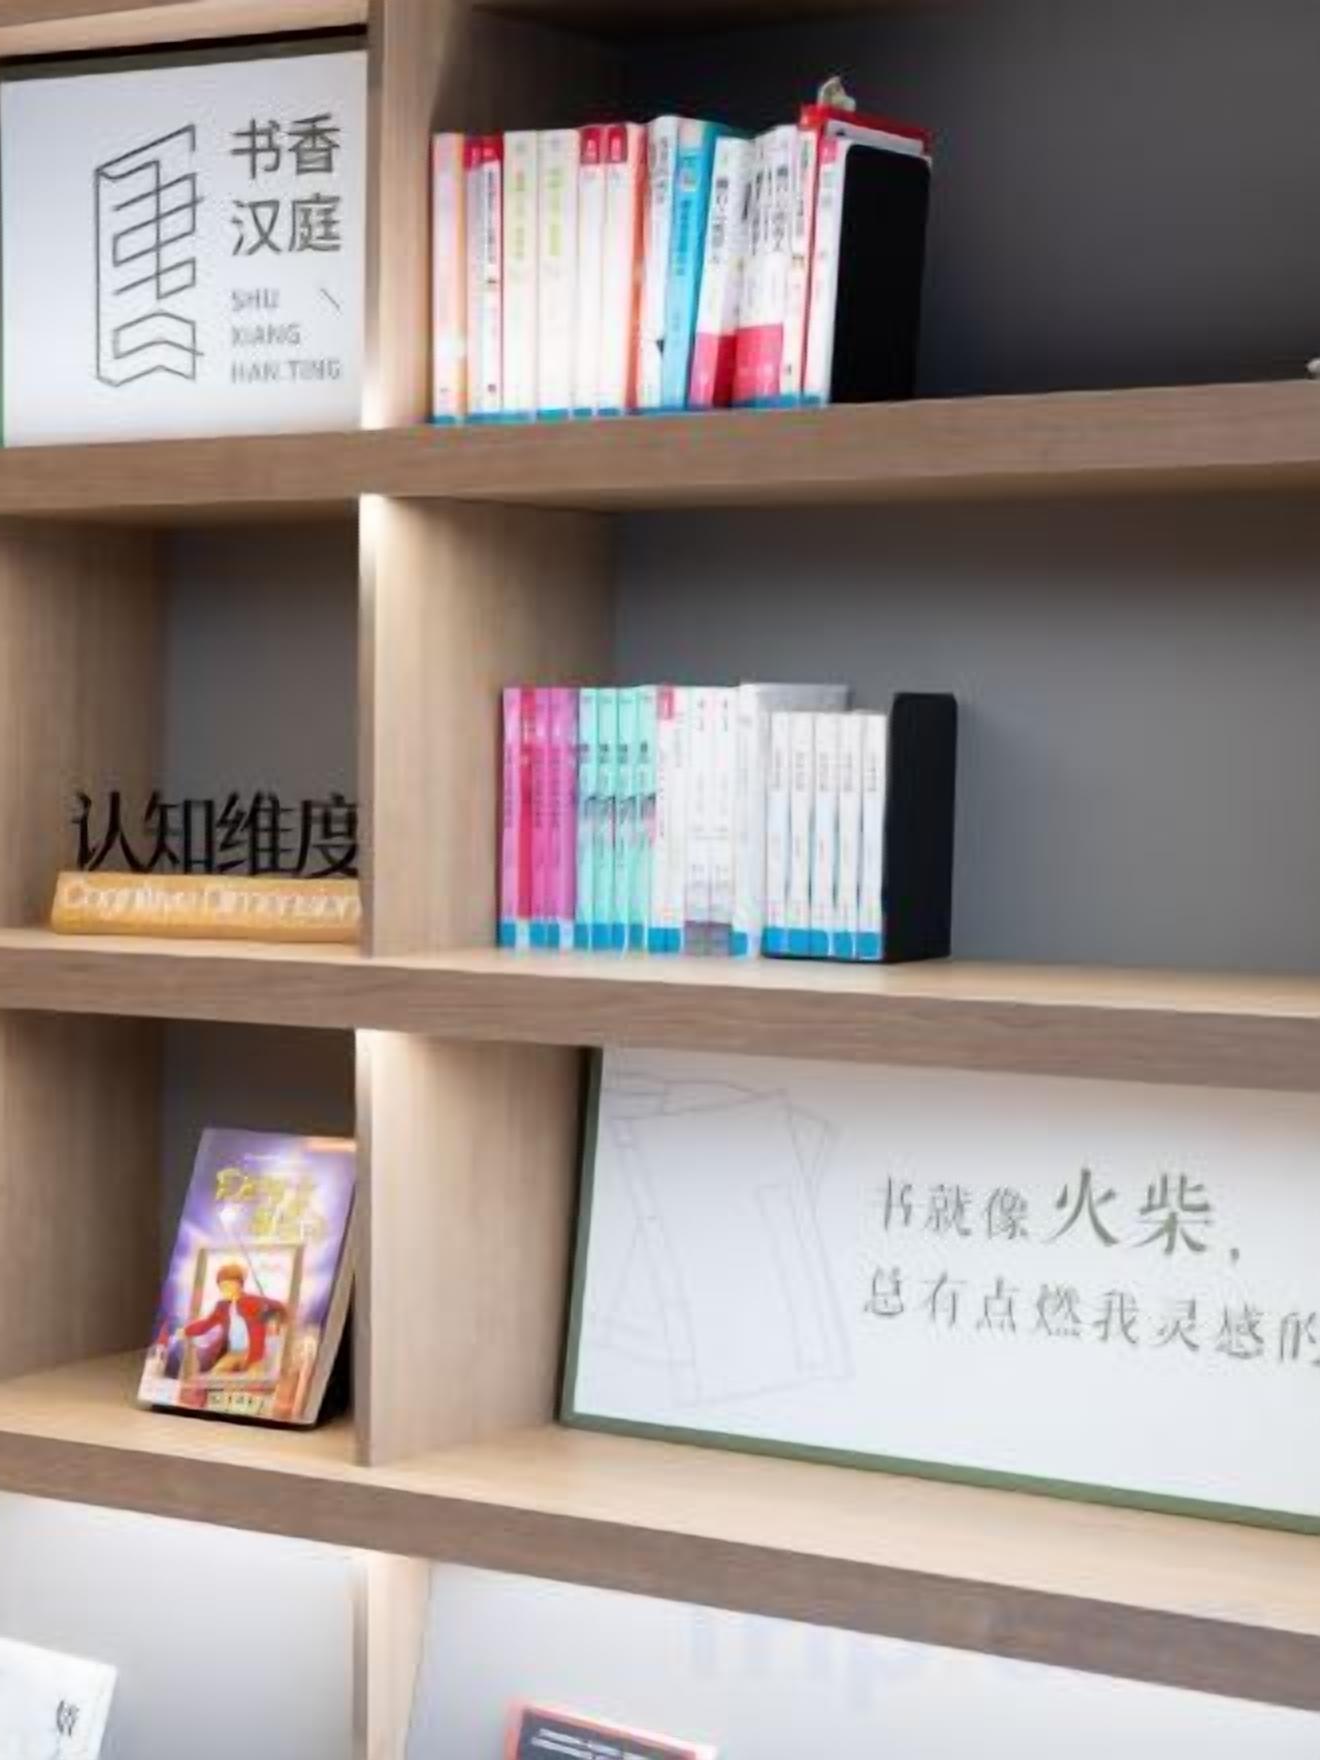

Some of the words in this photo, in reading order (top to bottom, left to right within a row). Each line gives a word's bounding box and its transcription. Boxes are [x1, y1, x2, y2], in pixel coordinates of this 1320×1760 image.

[230, 112, 342, 180] 书香
[230, 192, 342, 257] 汉庭
[231, 287, 281, 313] SHU
[231, 323, 302, 348] XIANG
[71, 790, 358, 878] 认知维度
